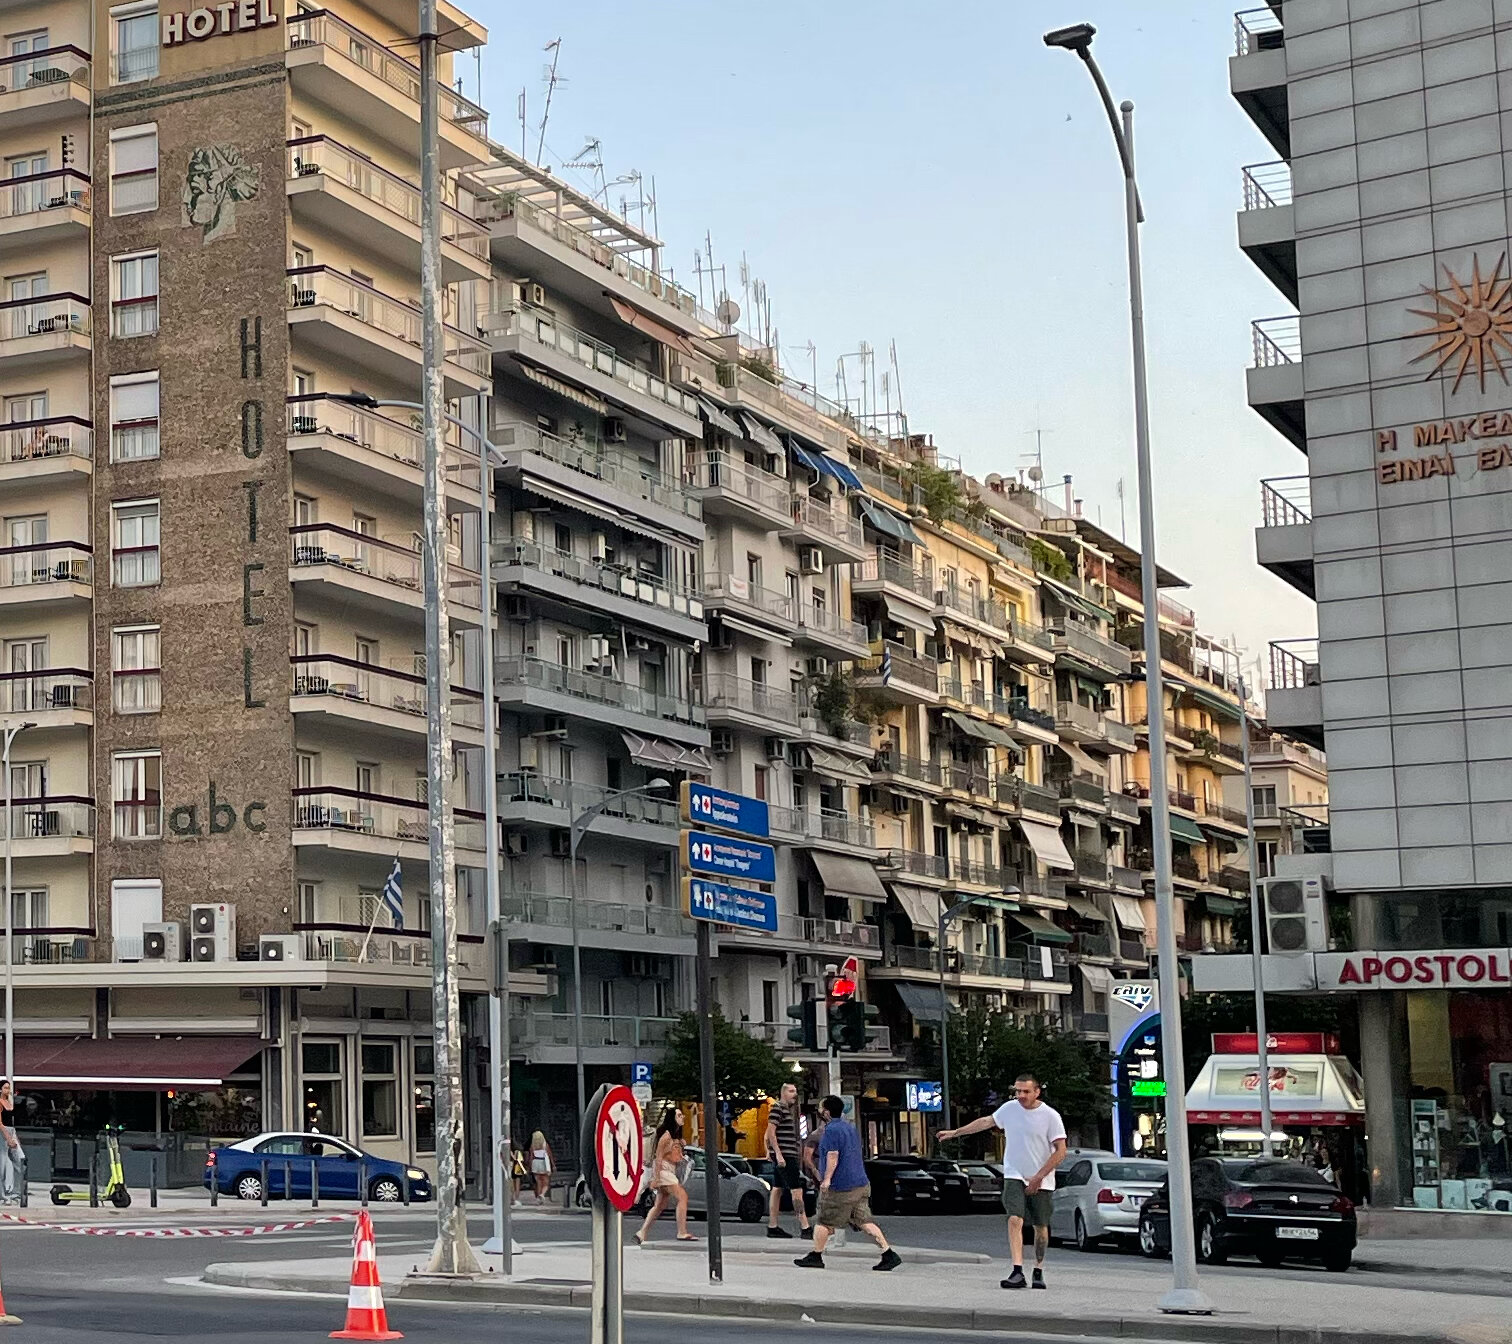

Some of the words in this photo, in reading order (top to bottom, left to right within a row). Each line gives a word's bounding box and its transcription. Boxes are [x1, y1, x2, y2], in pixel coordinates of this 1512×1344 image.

[1377, 452, 1456, 484] ΕΙΝΑΙ
[239, 316, 265, 709] HOTEL
[169, 774, 268, 835] abc
[1339, 955, 1512, 984] APOSTOL
[636, 1065, 648, 1080] P
